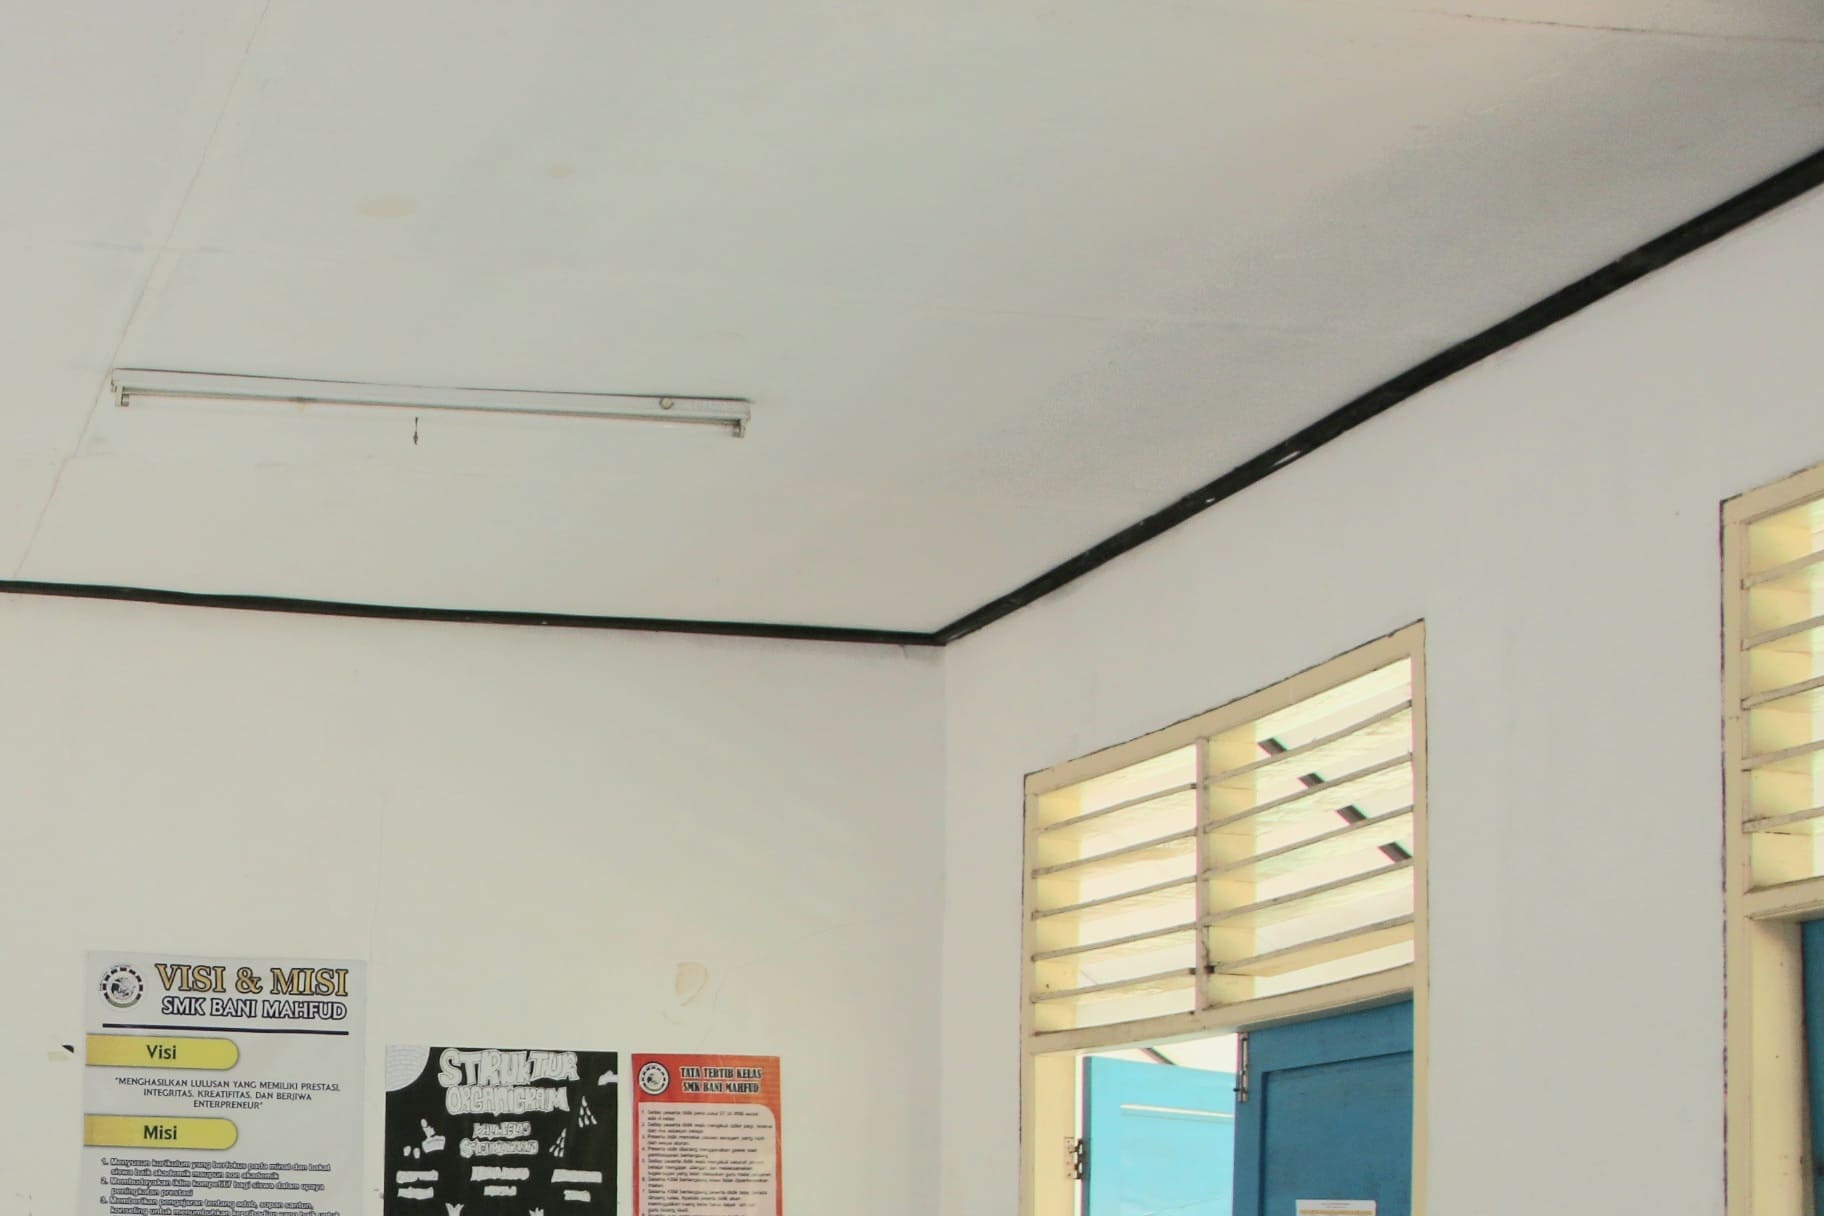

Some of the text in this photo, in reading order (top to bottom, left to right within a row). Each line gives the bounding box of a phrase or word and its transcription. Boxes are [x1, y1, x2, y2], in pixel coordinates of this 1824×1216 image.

[155, 963, 350, 996] VISI & MISI
[161, 996, 347, 1020] SMK BANI MAHFUD
[146, 1044, 177, 1061] Visi
[438, 1048, 580, 1087] STRUKTUR
[680, 1066, 762, 1079] TATA TERTIB KELAS
[190, 1079, 230, 1089] LULUSAN
[233, 1080, 257, 1089] YANG
[259, 1081, 298, 1090] MEMILIKI
[682, 1081, 700, 1093] SMK
[725, 1082, 759, 1093] MAHFUD
[255, 1091, 274, 1100] DAN
[276, 1092, 312, 1101] BERJIWA
[143, 1124, 178, 1141] Misi
